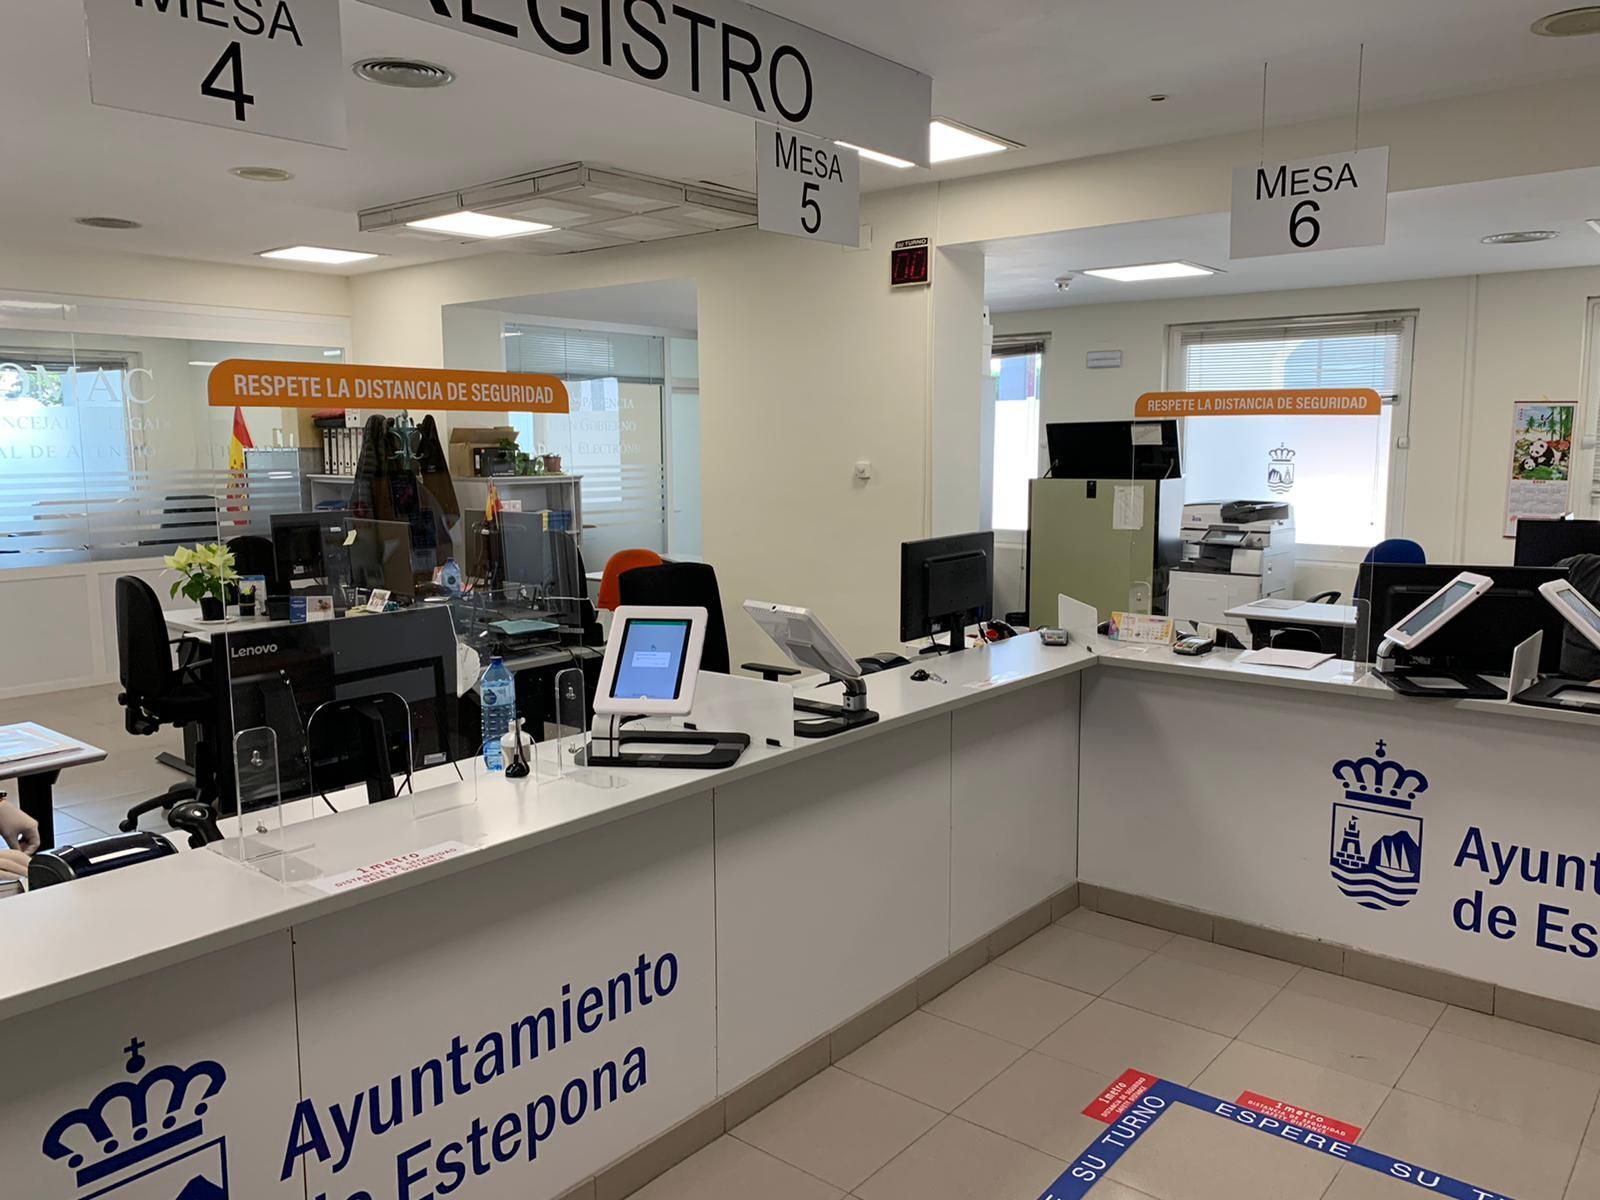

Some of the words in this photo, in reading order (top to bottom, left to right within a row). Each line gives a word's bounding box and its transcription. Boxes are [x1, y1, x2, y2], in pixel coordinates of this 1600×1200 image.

[201, 41, 254, 122] 4
[429, 0, 813, 123] GISTRO
[774, 131, 843, 184] MESA
[1255, 162, 1358, 200] MESA
[800, 182, 822, 234] 5
[1288, 200, 1321, 248] 6
[905, 238, 926, 246] TURNO
[233, 374, 322, 398] RESPETE
[326, 377, 350, 399] LA
[355, 379, 443, 401] DISTANCIA
[447, 382, 467, 401] DE
[471, 383, 554, 404] SEGURIDAD
[1147, 400, 1195, 411] RESPETE
[1198, 399, 1212, 410] LA
[1214, 398, 1272, 409] DISTANCIA
[1277, 397, 1293, 408] DE
[1296, 396, 1367, 408] SEGURIDAD
[231, 644, 278, 658] Lenovo
[370, 852, 420, 870] metro
[1452, 889, 1517, 940] de
[1536, 903, 1600, 958] Es
[280, 952, 678, 1182] Ayuntamiento
[1104, 1082, 1127, 1100] metro
[396, 1046, 648, 1200] Estepona
[1247, 1100, 1286, 1116] DISTANCIA
[1303, 1118, 1347, 1137] SEGURIDAD
[1284, 1106, 1324, 1122] metro
[1072, 1155, 1107, 1182] SU
[1102, 1096, 1166, 1147] TURNO
[1215, 1102, 1352, 1158] ESPERE
[1390, 1162, 1440, 1188] SU
